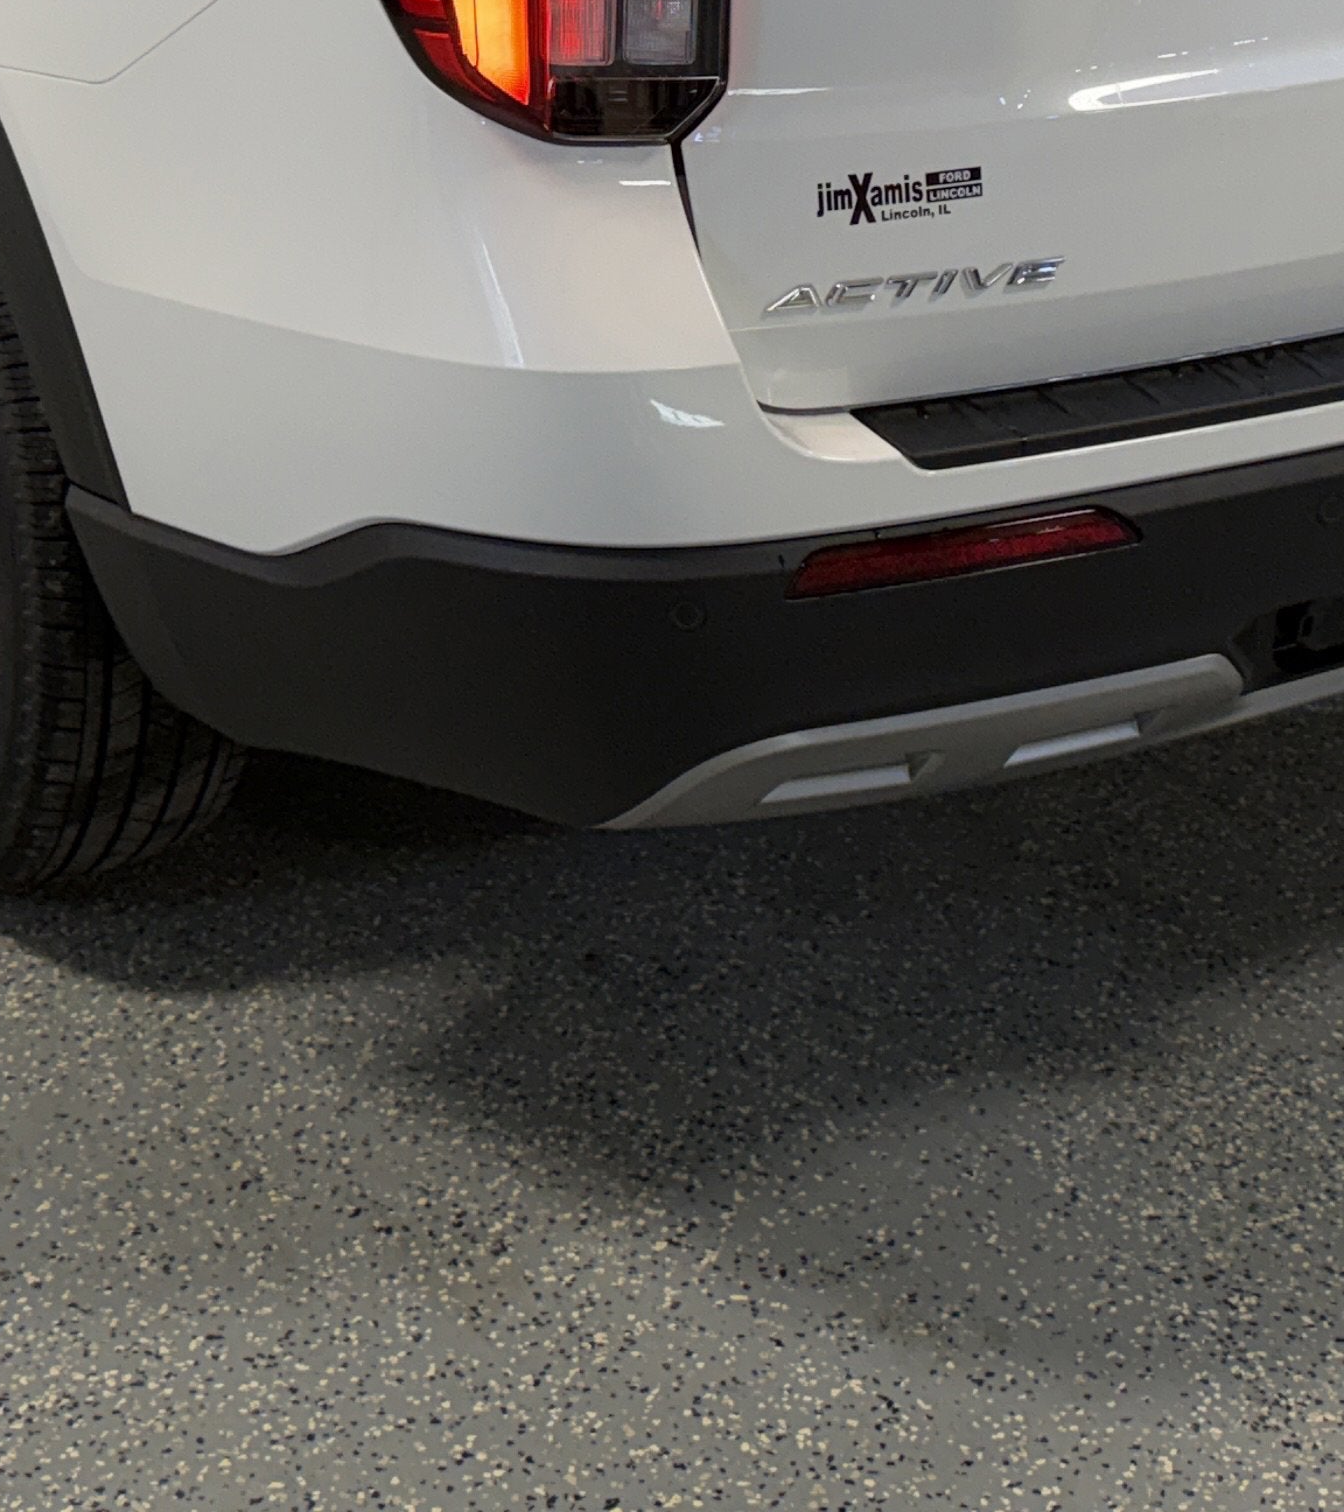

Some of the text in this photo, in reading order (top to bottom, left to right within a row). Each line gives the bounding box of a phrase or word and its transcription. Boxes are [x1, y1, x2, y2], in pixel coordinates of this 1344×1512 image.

[938, 169, 972, 184] FORD
[817, 172, 924, 225] jimXamis
[928, 184, 982, 202] LINCOLN
[881, 204, 951, 222] Lincoln, IL
[764, 256, 1065, 313] ACTIVE
